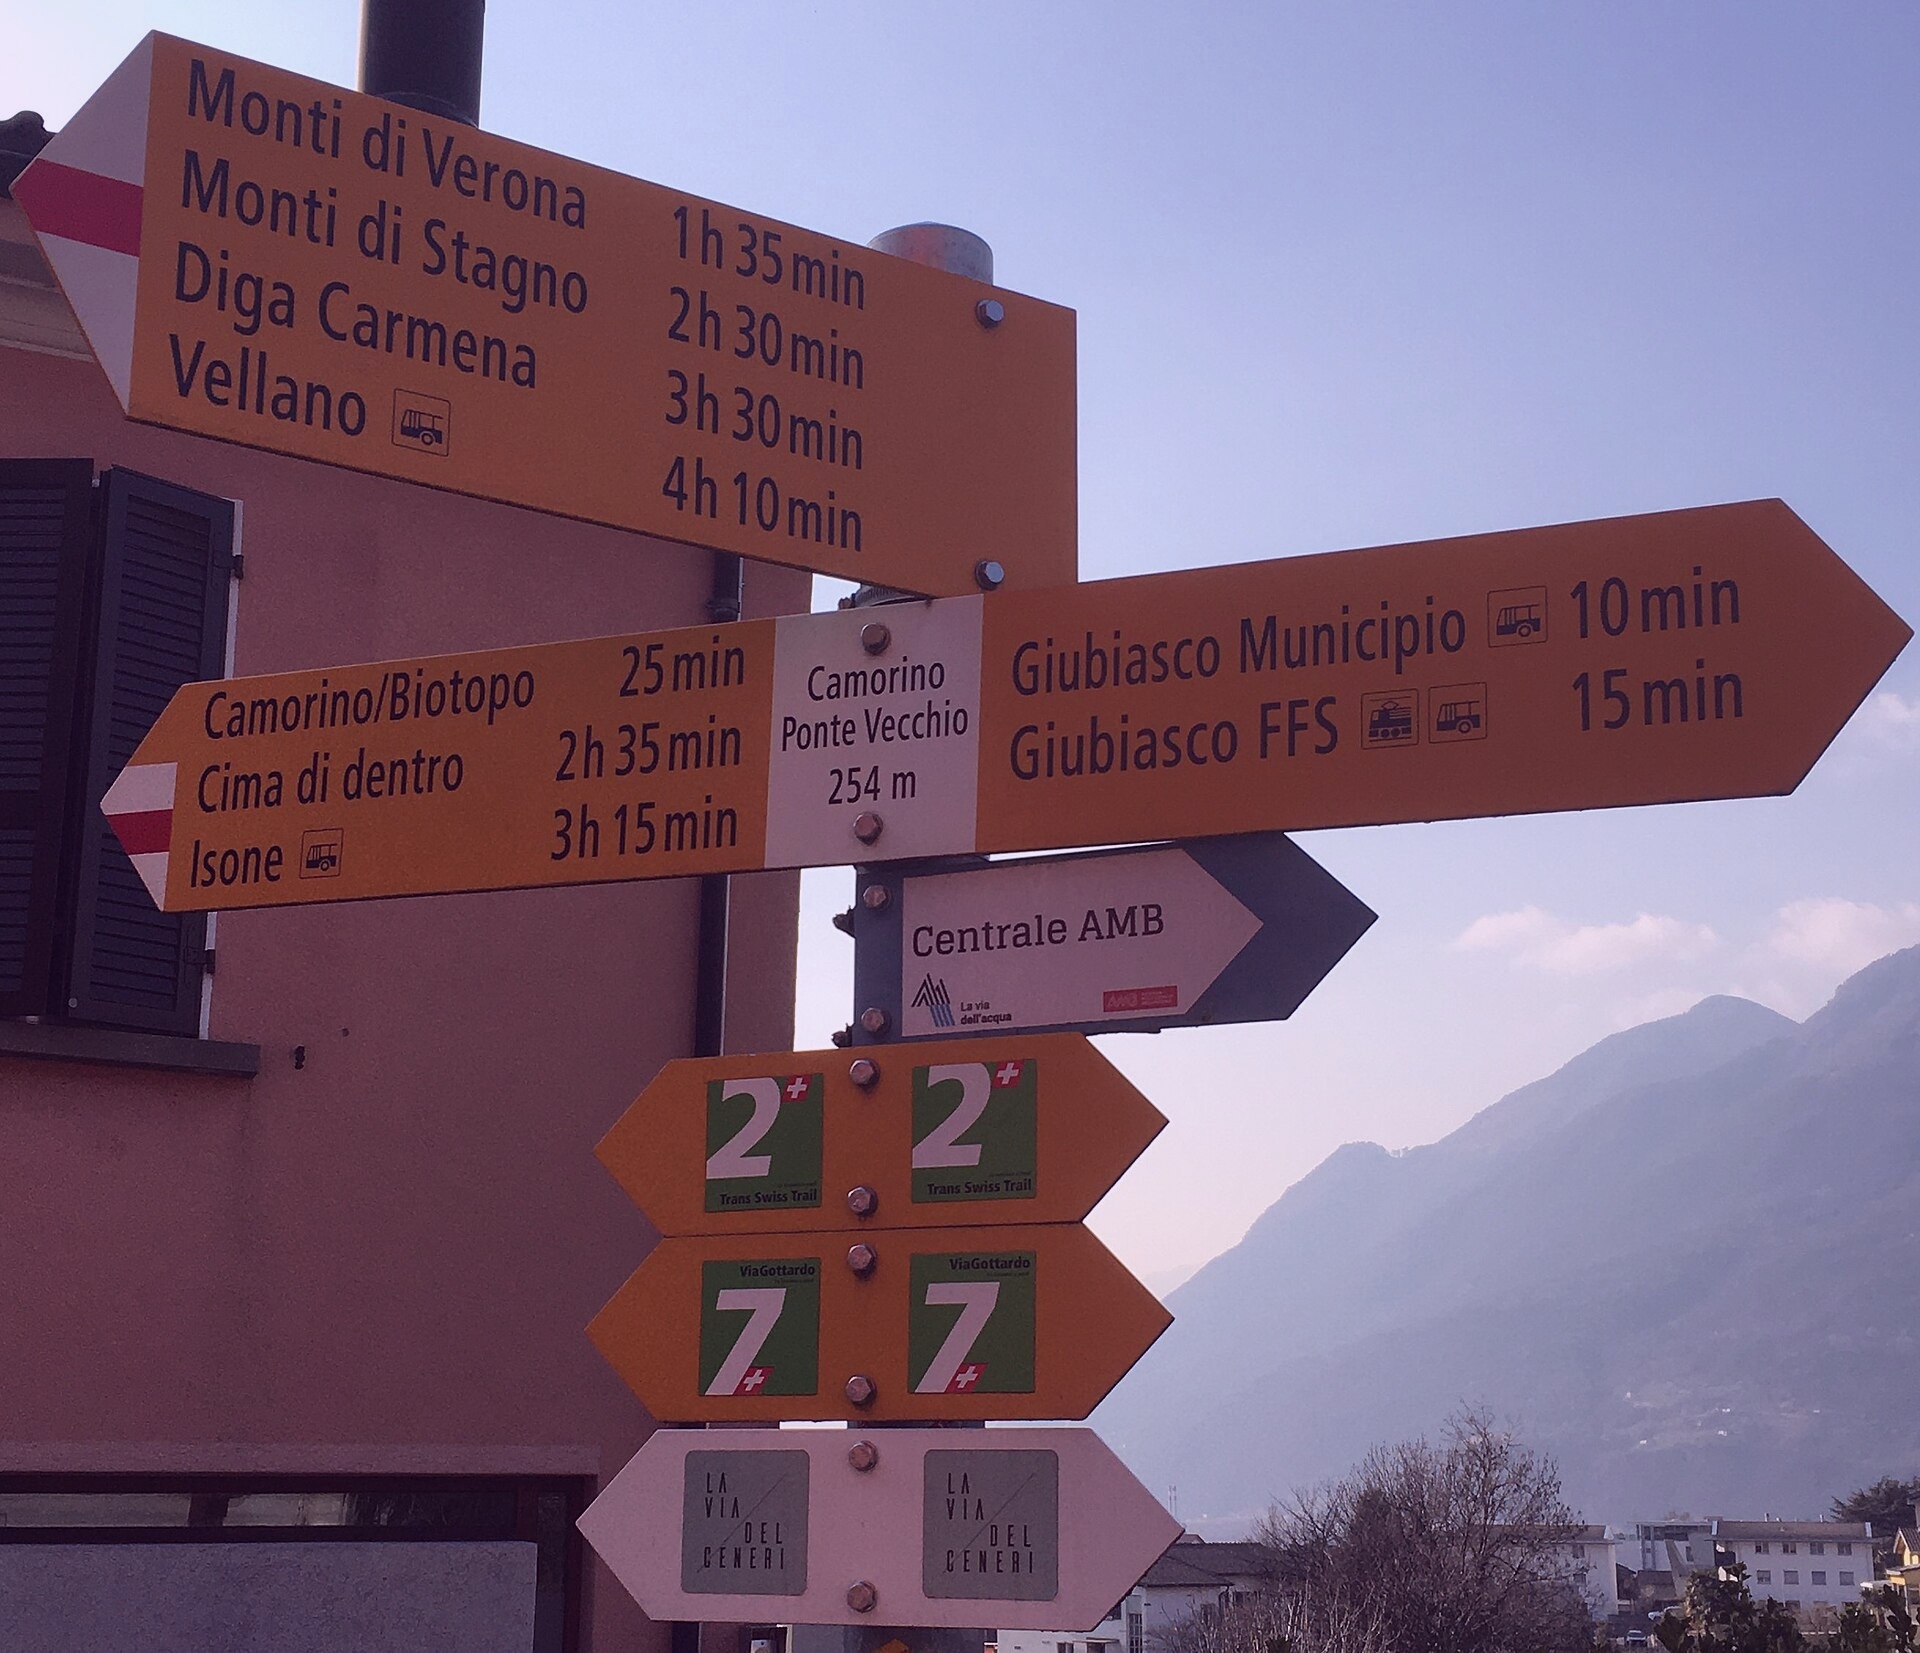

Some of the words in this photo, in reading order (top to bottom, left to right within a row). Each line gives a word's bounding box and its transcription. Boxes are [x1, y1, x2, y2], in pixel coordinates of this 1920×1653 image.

[188, 59, 341, 158] Monti
[363, 112, 405, 177] di
[423, 128, 586, 229] Verona
[181, 149, 335, 246] Monti
[358, 199, 401, 264] di
[423, 218, 588, 314] Stagno
[175, 242, 295, 335] Diga
[319, 281, 537, 389] Carmena
[169, 334, 367, 436] Vellano
[1012, 631, 1220, 696] Giubiasco
[1240, 595, 1465, 675] Municipio
[808, 656, 945, 701] Camorino
[204, 667, 535, 741] Camorino/Biotopo
[782, 715, 856, 751] Ponte
[864, 699, 968, 743] Vecchio
[1010, 714, 1238, 781] Giubiasco
[1259, 696, 1338, 759] FFS
[198, 763, 283, 814] Cima
[297, 751, 329, 804] di
[343, 747, 463, 801] dentro
[828, 765, 880, 805] 254
[892, 769, 916, 800] m
[191, 840, 283, 889] Isone
[912, 915, 1067, 957] Centrale
[1078, 903, 1164, 942] AMB
[960, 1002, 973, 1012] La
[975, 1000, 990, 1010] via
[960, 1013, 1012, 1024] dell'acqua
[706, 1077, 781, 1179] 2
[912, 1062, 991, 1169] 2
[720, 1193, 752, 1205] Trans
[754, 1190, 788, 1203] Swiss
[791, 1188, 817, 1201] Trail
[927, 1183, 961, 1195] Trans
[964, 1181, 1001, 1194] Swiss
[1003, 1178, 1032, 1192] Trail
[740, 1263, 815, 1277] ViaGottardo
[949, 1256, 1031, 1270] ViaGottardo
[705, 1288, 786, 1395] 7
[914, 1282, 1000, 1393] 7
[706, 1472, 727, 1494] LA
[947, 1472, 970, 1494] LA
[705, 1497, 740, 1519] VIA
[946, 1498, 984, 1521] VIA
[744, 1522, 783, 1545] DEL
[989, 1524, 1031, 1548] DEL
[703, 1546, 785, 1570] CENERI
[946, 1549, 1033, 1574] CENERI
